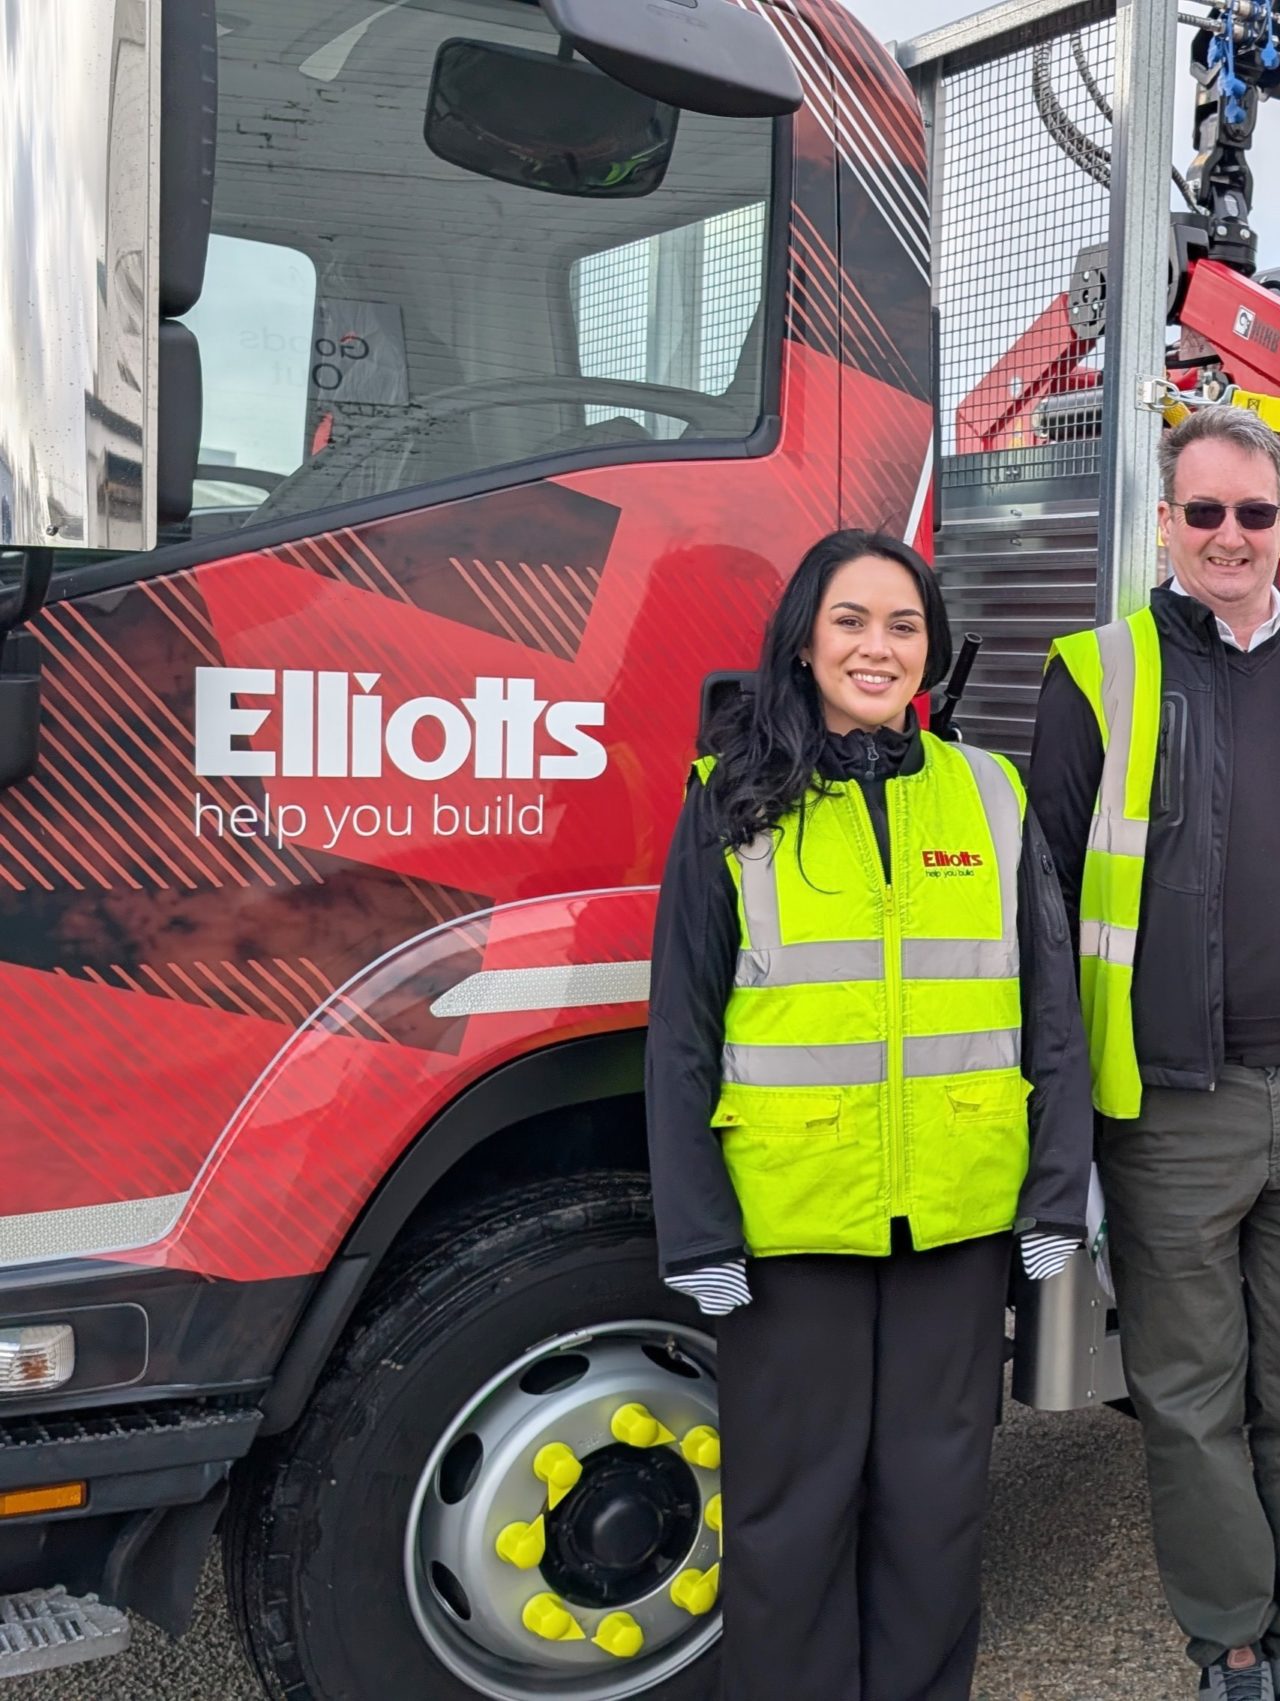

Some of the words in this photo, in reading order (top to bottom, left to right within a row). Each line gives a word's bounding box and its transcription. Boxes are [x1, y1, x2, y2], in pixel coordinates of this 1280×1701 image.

[195, 666, 608, 781] Elliotts
[195, 793, 307, 849] help
[322, 804, 412, 849] you
[433, 794, 544, 836] build
[922, 850, 983, 867] Elliotts
